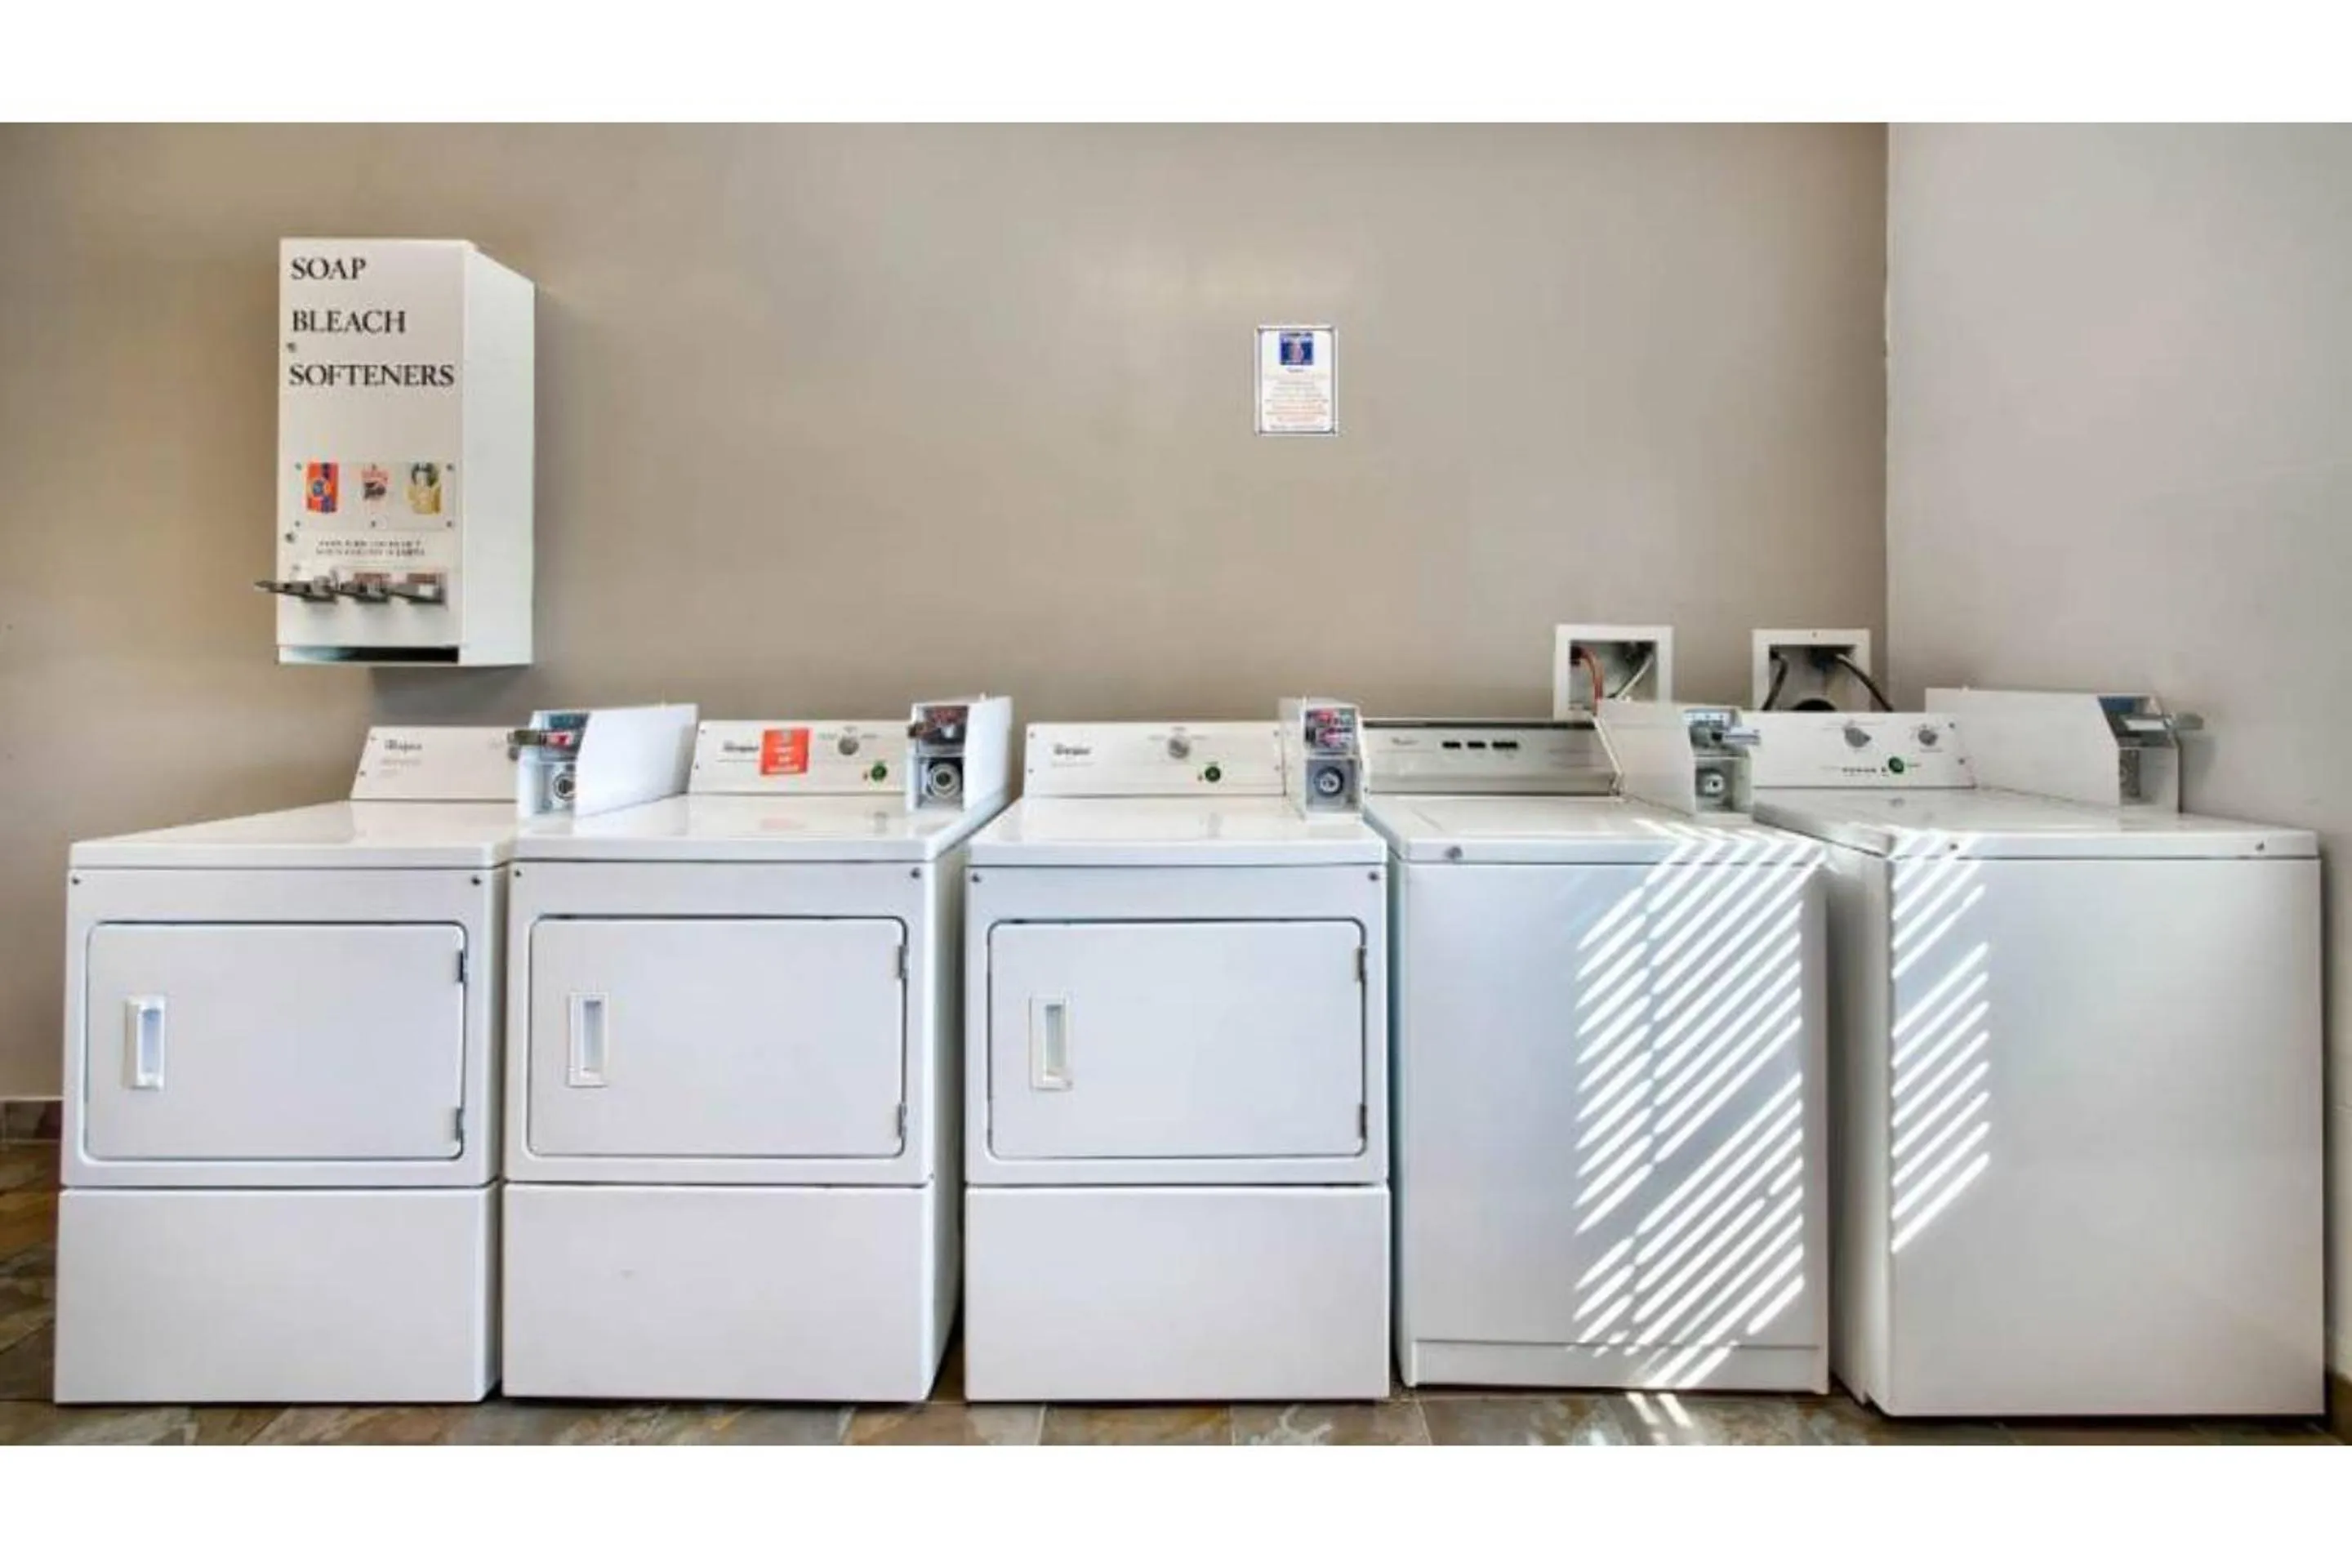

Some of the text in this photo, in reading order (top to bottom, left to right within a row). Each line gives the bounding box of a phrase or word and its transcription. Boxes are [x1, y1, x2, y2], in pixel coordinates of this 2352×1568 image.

[290, 256, 367, 280] SOAP
[292, 309, 407, 334] BLEACH
[288, 363, 455, 387] SOFTENERS
